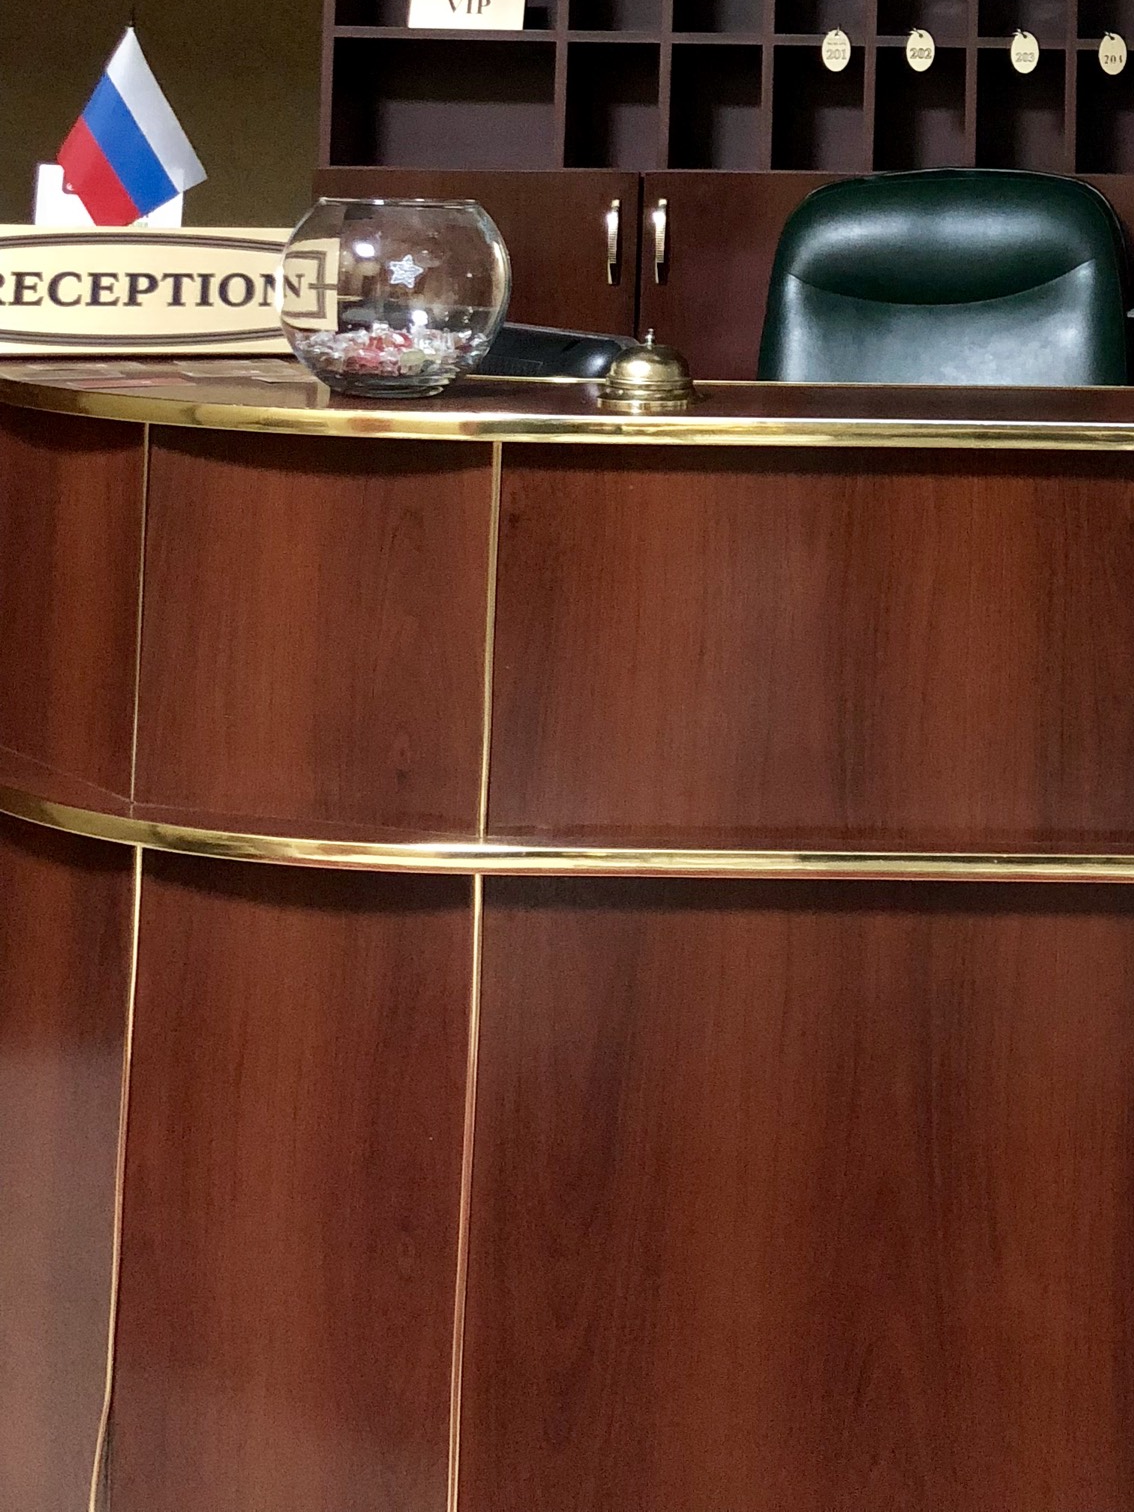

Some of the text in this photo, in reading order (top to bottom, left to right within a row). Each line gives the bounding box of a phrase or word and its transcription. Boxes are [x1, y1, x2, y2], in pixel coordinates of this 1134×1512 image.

[825, 48, 848, 60] 201
[909, 48, 933, 60] 202
[0, 270, 305, 307] ECEPTION
